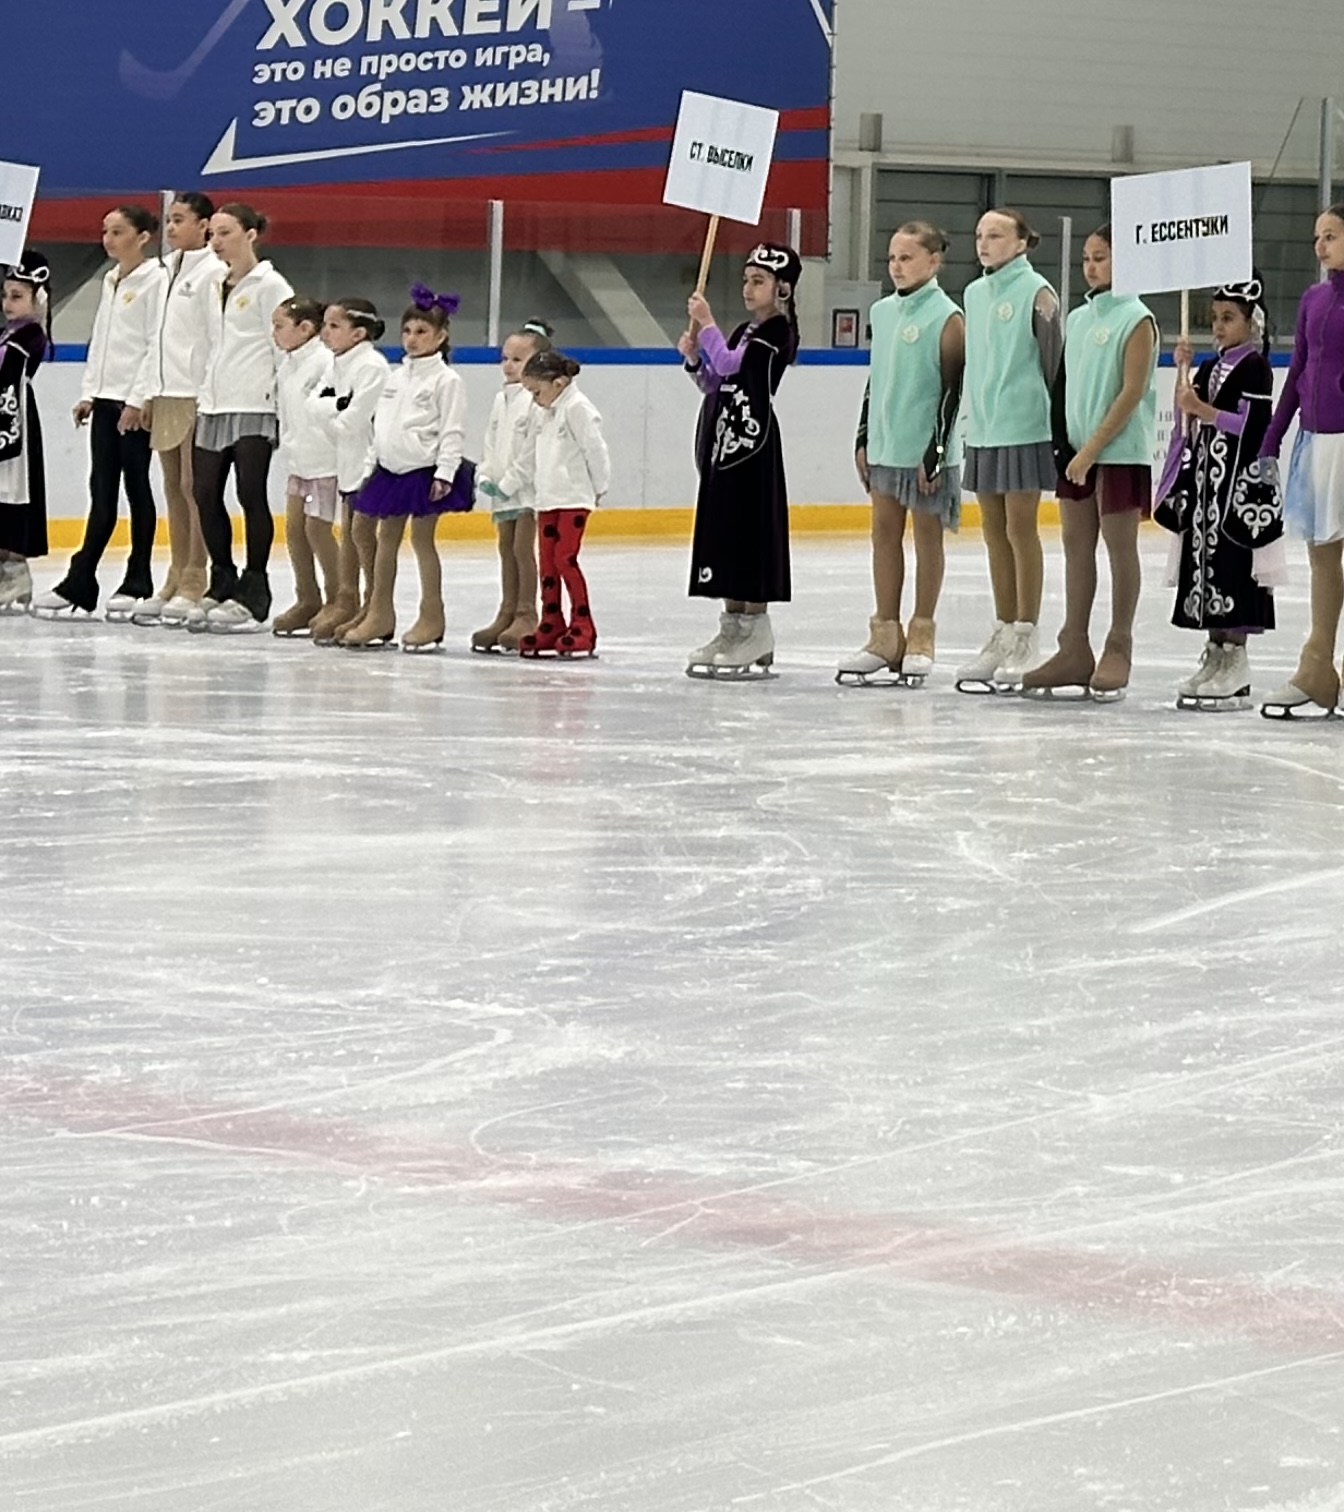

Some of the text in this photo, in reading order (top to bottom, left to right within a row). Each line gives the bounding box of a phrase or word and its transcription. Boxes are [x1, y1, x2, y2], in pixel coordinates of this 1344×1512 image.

[252, 43, 550, 84] это не просто игра,
[252, 69, 601, 128] это образ жизни!
[707, 145, 754, 172] ВЫСЕЛКИ
[1136, 214, 1229, 245] Г. ЕССЕНТУКИ
